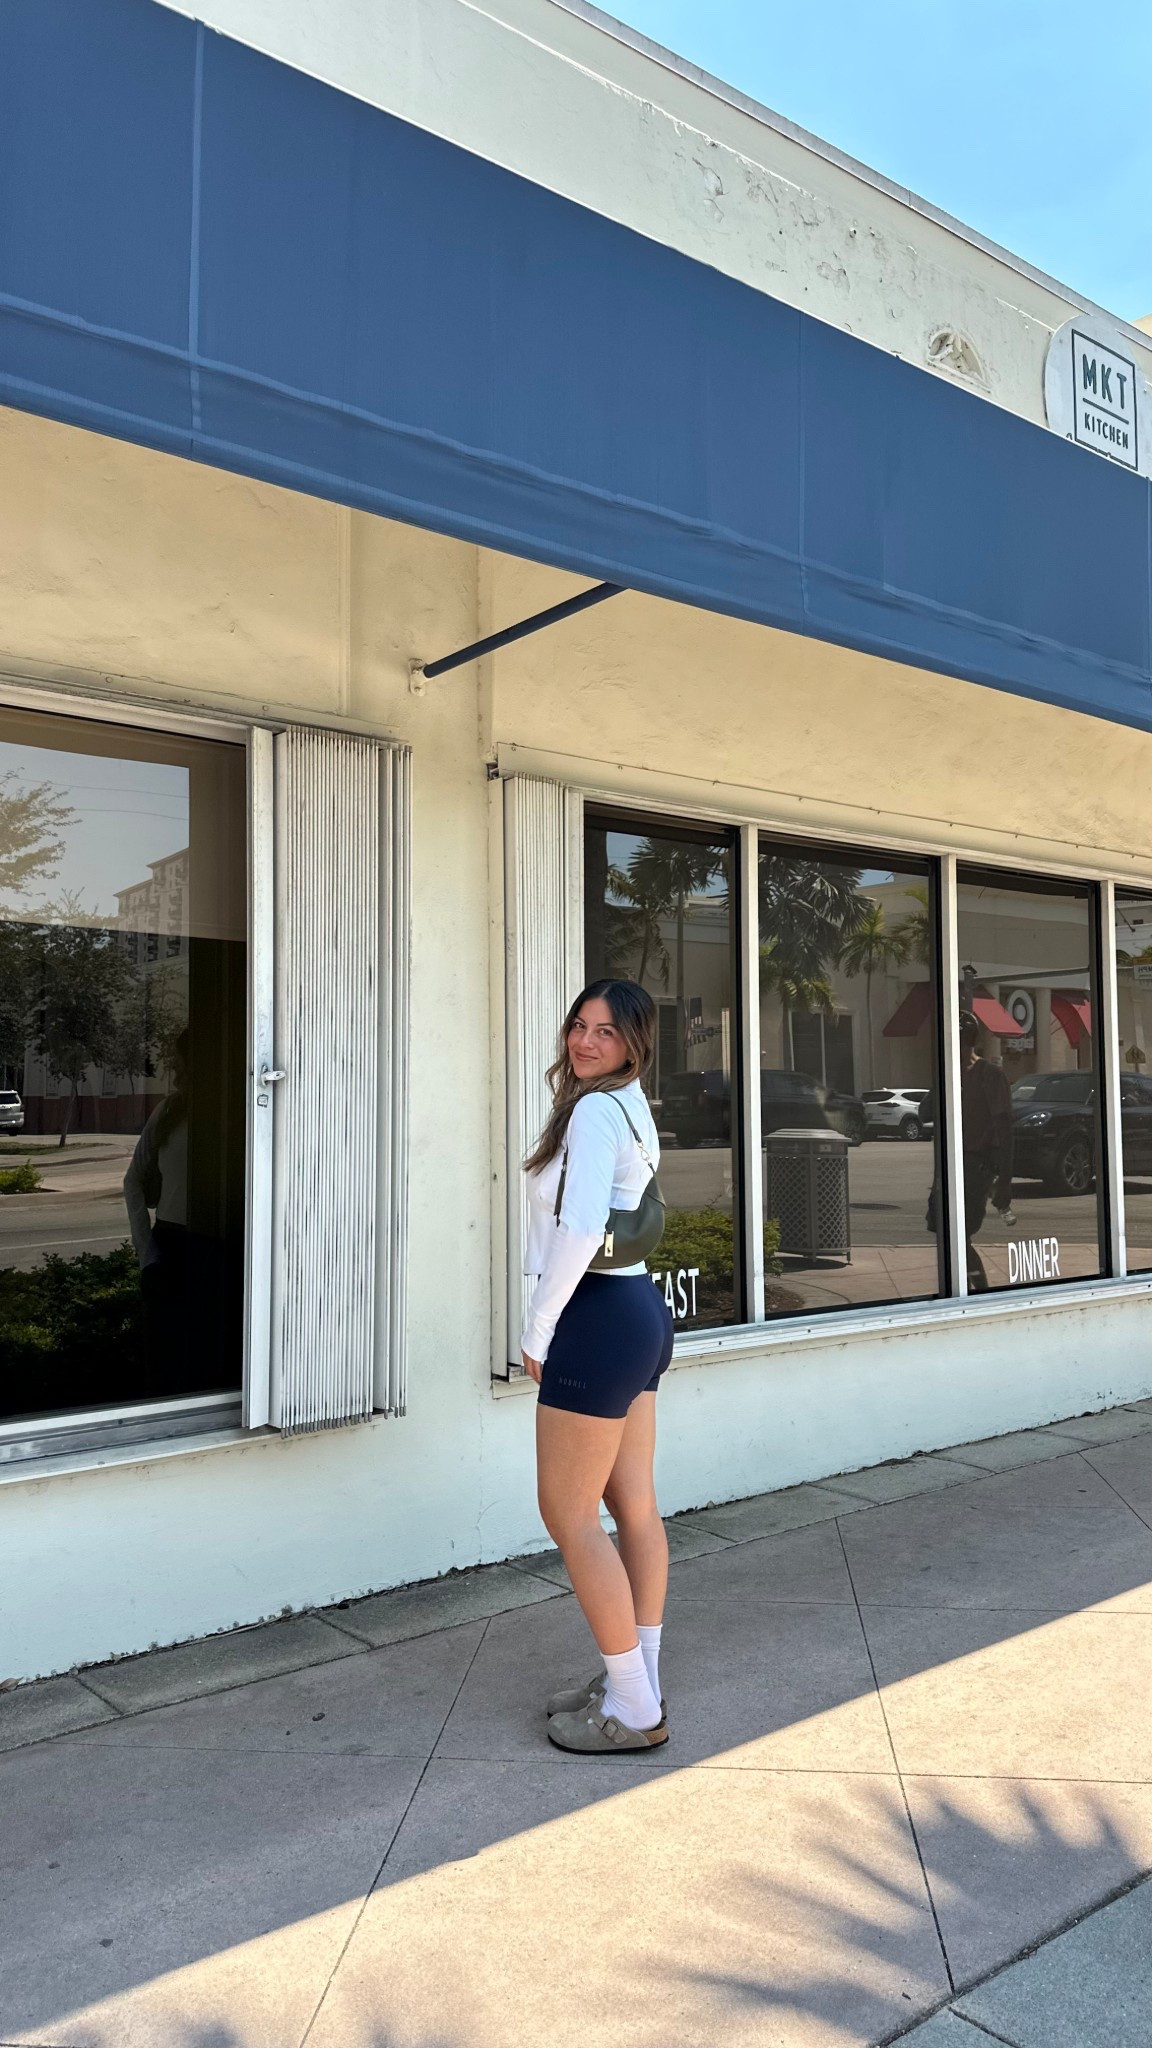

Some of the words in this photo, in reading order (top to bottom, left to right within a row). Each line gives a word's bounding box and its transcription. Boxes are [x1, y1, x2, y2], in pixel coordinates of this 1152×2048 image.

[1083, 354, 1127, 409] MKT
[1084, 412, 1129, 449] KITCHEN
[1008, 1237, 1060, 1283] DINNER
[652, 1268, 699, 1319] AST
